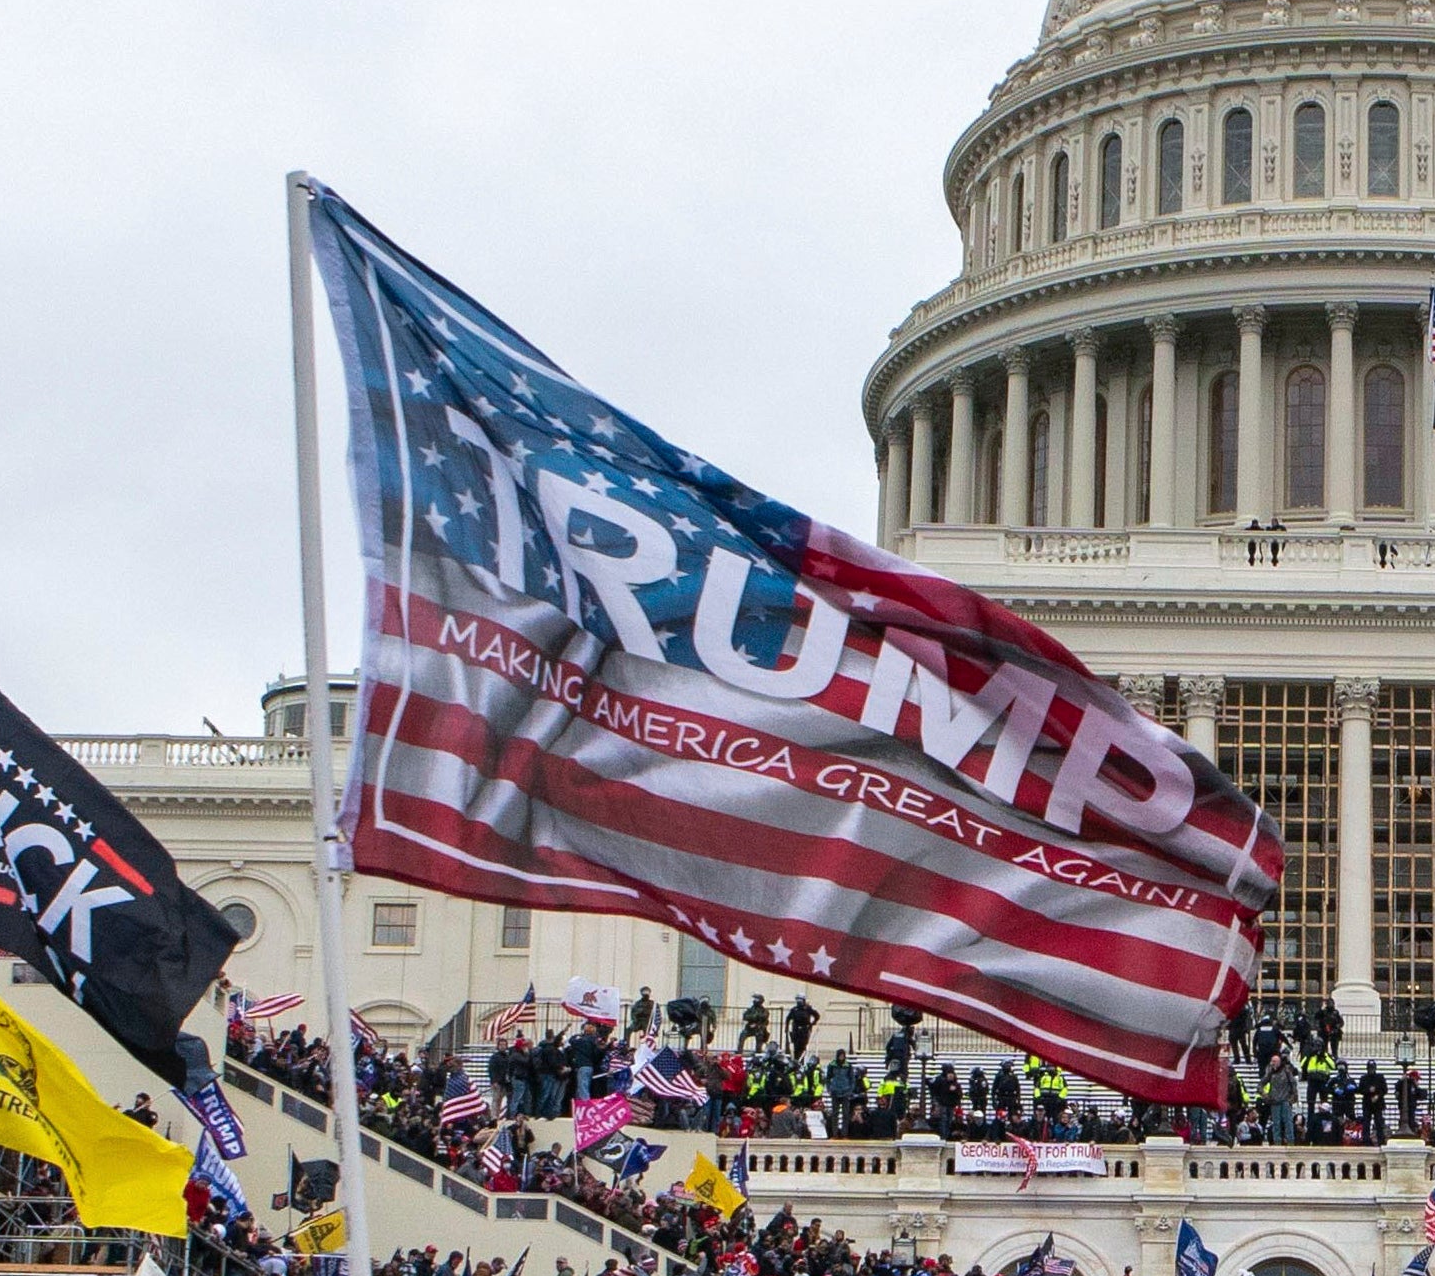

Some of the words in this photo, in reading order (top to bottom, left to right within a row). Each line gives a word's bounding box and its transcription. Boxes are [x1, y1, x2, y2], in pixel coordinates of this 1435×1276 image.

[445, 406, 1196, 838] TRUMP
[439, 613, 586, 717] MAKING
[593, 691, 798, 781] AMERICA
[816, 761, 1002, 852] GREAT
[1012, 843, 1201, 914] AGAIN!
[200, 1082, 239, 1157] TRUMP
[961, 1144, 1009, 1159] GEORGIA
[1046, 1144, 1068, 1159] FOR
